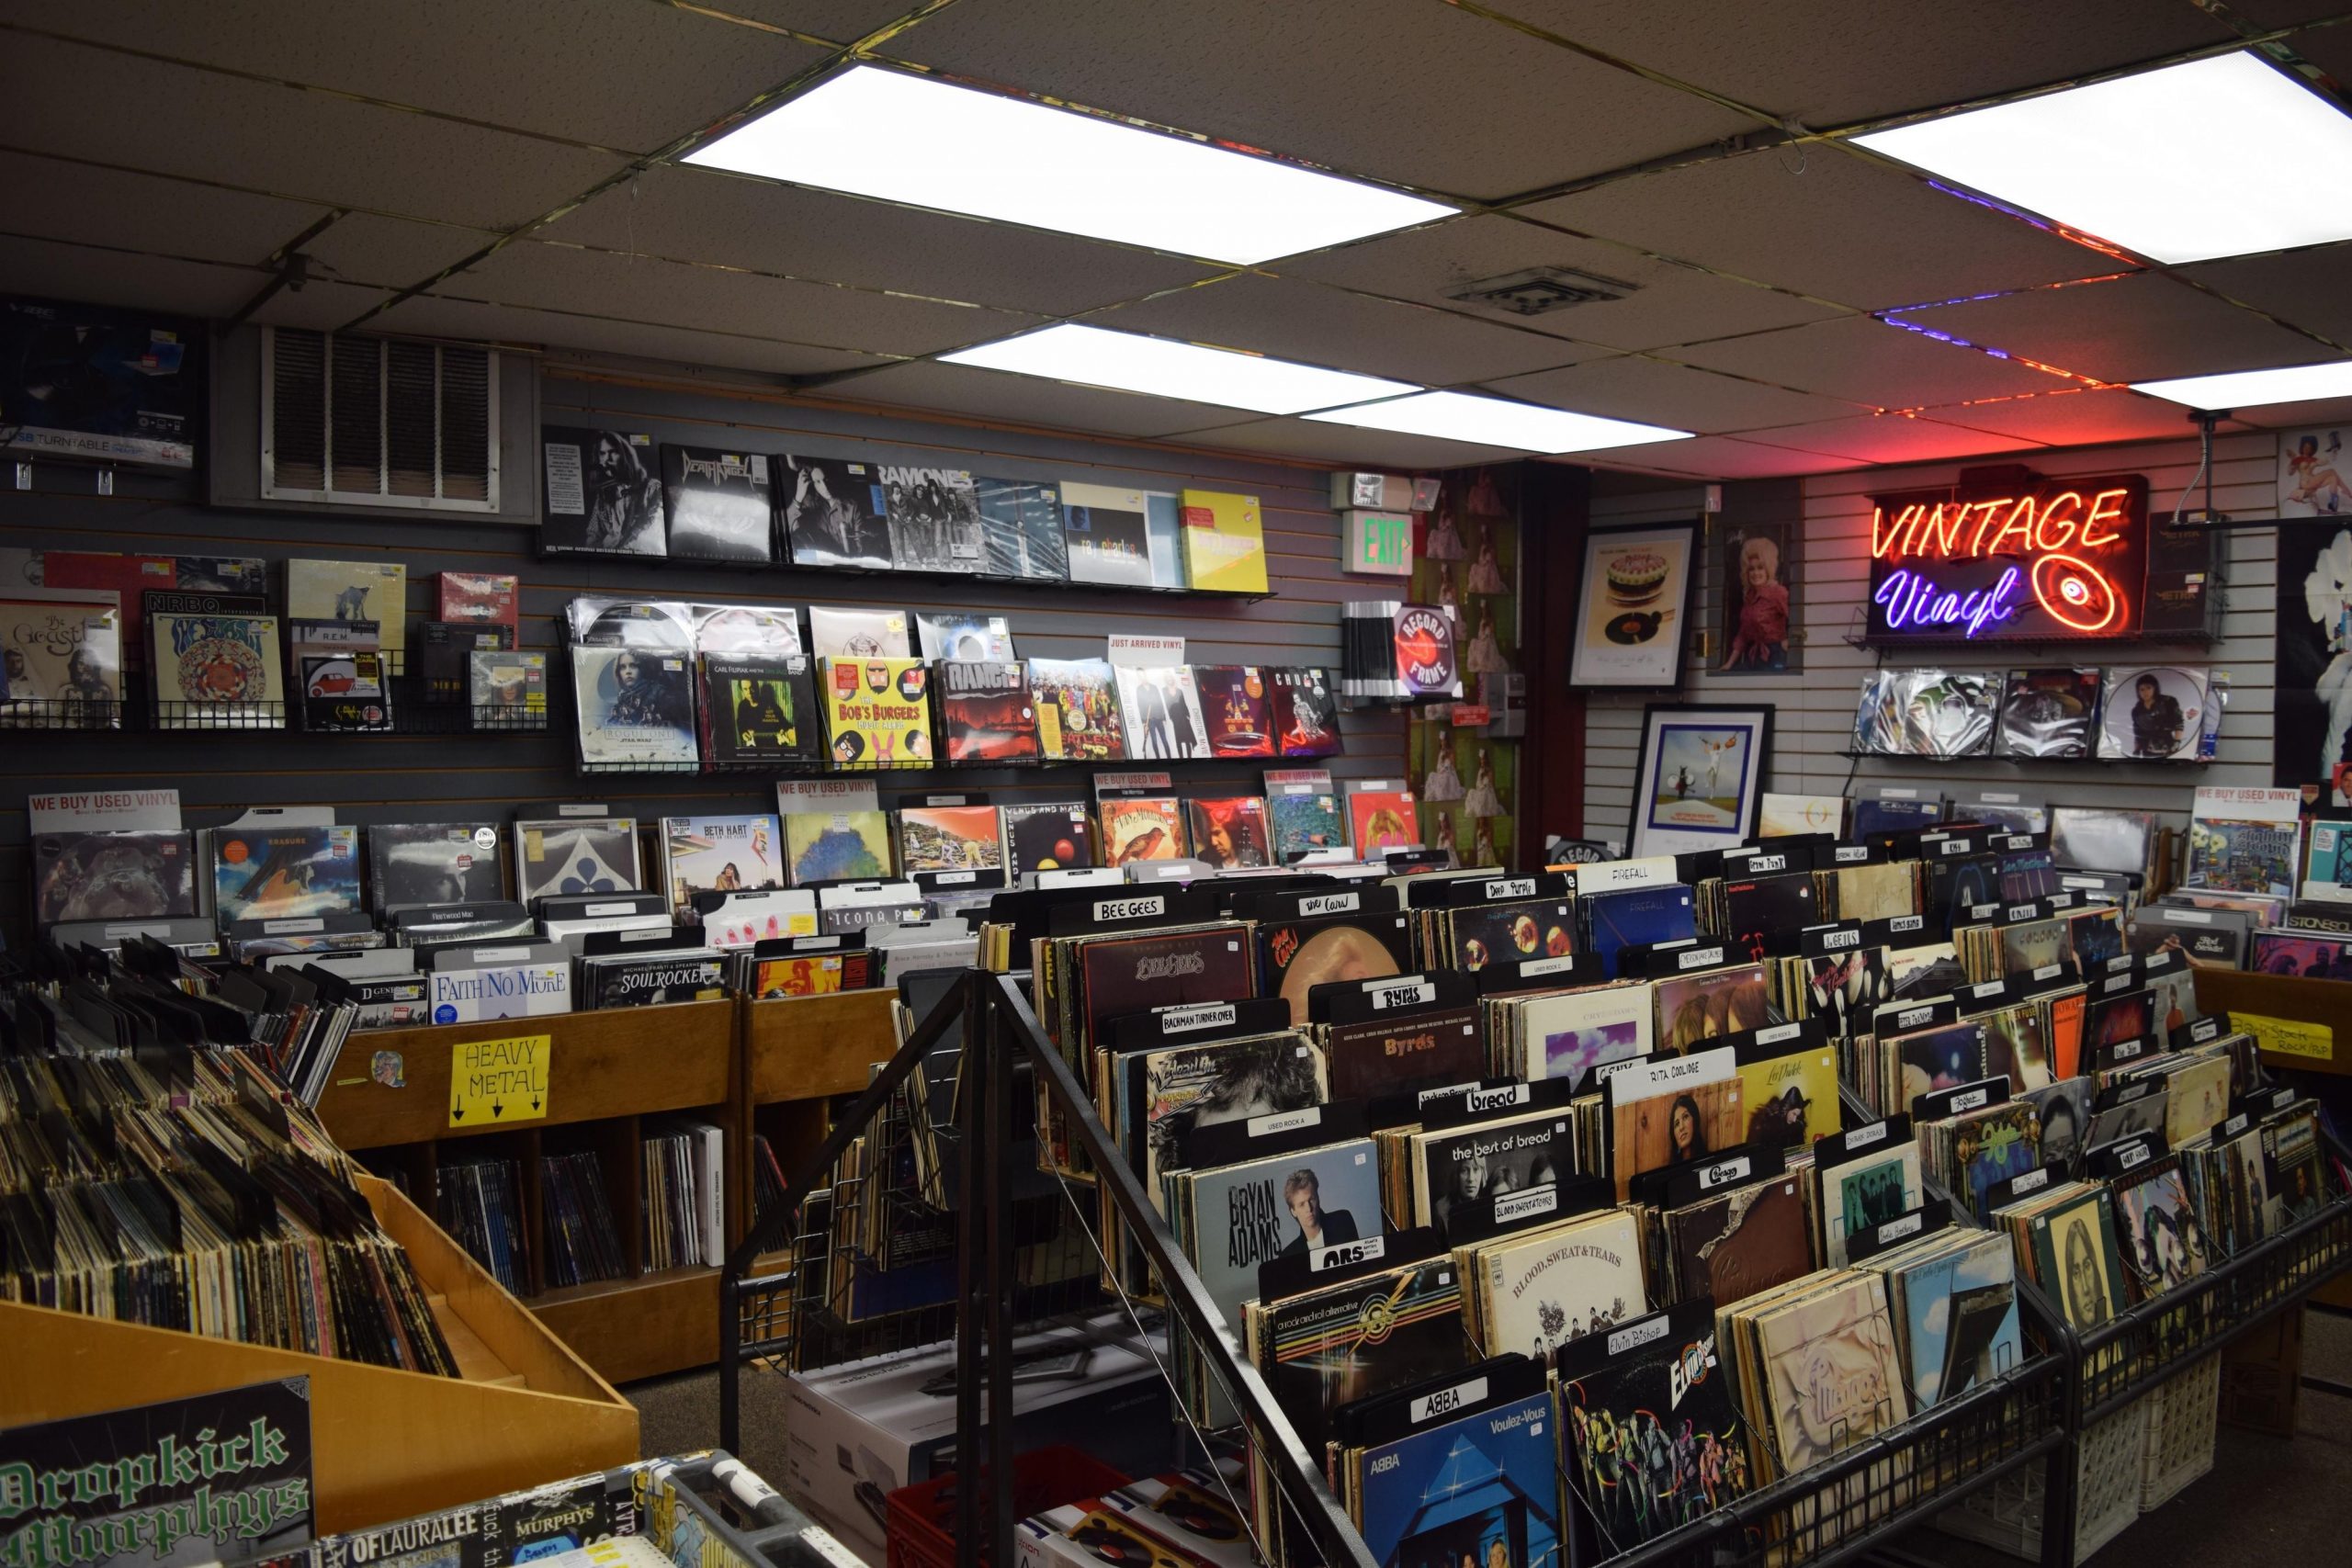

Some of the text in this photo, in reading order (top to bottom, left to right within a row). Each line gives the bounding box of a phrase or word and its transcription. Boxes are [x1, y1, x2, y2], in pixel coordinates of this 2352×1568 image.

[37, 434, 109, 452] TURNTABLE
[876, 465, 972, 489] RAMONES
[1872, 490, 2128, 558] VINTAGE
[1081, 538, 1136, 559] ray charles
[1364, 518, 1407, 565] EXIT
[149, 594, 220, 614] NRBQ
[1874, 568, 2018, 638] Vinyl
[1403, 613, 1445, 640] RECORD
[1111, 639, 1182, 649] JUST ARRIVED VINYL
[714, 666, 728, 674] CARL
[1409, 661, 1448, 684] FRAME
[861, 696, 873, 705] THE
[839, 704, 920, 720] BOB'S BURGERS
[1095, 774, 1170, 785] WE BUY USED VINYL
[1264, 771, 1329, 781] WE BUY USED VINYL
[779, 781, 876, 795] WE BUY USED VINYL
[2197, 788, 2297, 801] WE BUY USED VINYL
[32, 794, 176, 810] WE BUY USED VINYL
[1006, 806, 1036, 814] VENUS
[1059, 805, 1086, 813] MARS
[704, 825, 747, 836] BETH HART
[1559, 845, 1600, 863] RECOR
[1612, 868, 1648, 880] FIREFALL
[836, 908, 926, 925] ICONA PP
[1102, 901, 1158, 918] BEE GEES
[1630, 901, 1665, 912] FIREFALL
[436, 970, 565, 1001] FAITH NO MORE
[620, 966, 711, 994] SOULROCKER
[362, 985, 424, 999] D GENEN
[1164, 1010, 1234, 1029] BACHMAN TURNER OVER
[2231, 1017, 2308, 1041] Back Stock
[466, 1039, 538, 1069] HEAVY
[1385, 1034, 1436, 1056] Byrds
[1650, 1070, 1669, 1082] RITA
[1671, 1062, 1700, 1079] COOLIDGE
[469, 1068, 545, 1099] METAL
[1471, 1087, 1517, 1110] bread
[1268, 1121, 1283, 1130] USED
[1283, 1119, 1298, 1128] ROCK
[1453, 1129, 1551, 1161] the best of bread
[1709, 1166, 1736, 1184] Chicago
[1228, 1179, 1277, 1228] BRYAN
[1496, 1204, 1514, 1217] BLOOD
[1515, 1200, 1532, 1213] SWEAT
[1537, 1195, 1553, 1208] TEARS
[1228, 1215, 1282, 1269] ADAMS
[1324, 1247, 1364, 1268] ARS
[1512, 1246, 1622, 1299] BLOOD, SWEAT & TEARS
[1278, 1301, 1358, 1330] a rock and roll alternative
[1610, 1326, 1661, 1354] Elvin Bishop
[1426, 1389, 1460, 1416] ABBA
[1490, 1406, 1546, 1435] Voulez-Vous
[0, 1416, 288, 1517] Dropkick
[1370, 1453, 1400, 1475] ABBA
[2, 1478, 310, 1568] Murphys
[516, 1506, 594, 1537] MURPHYS
